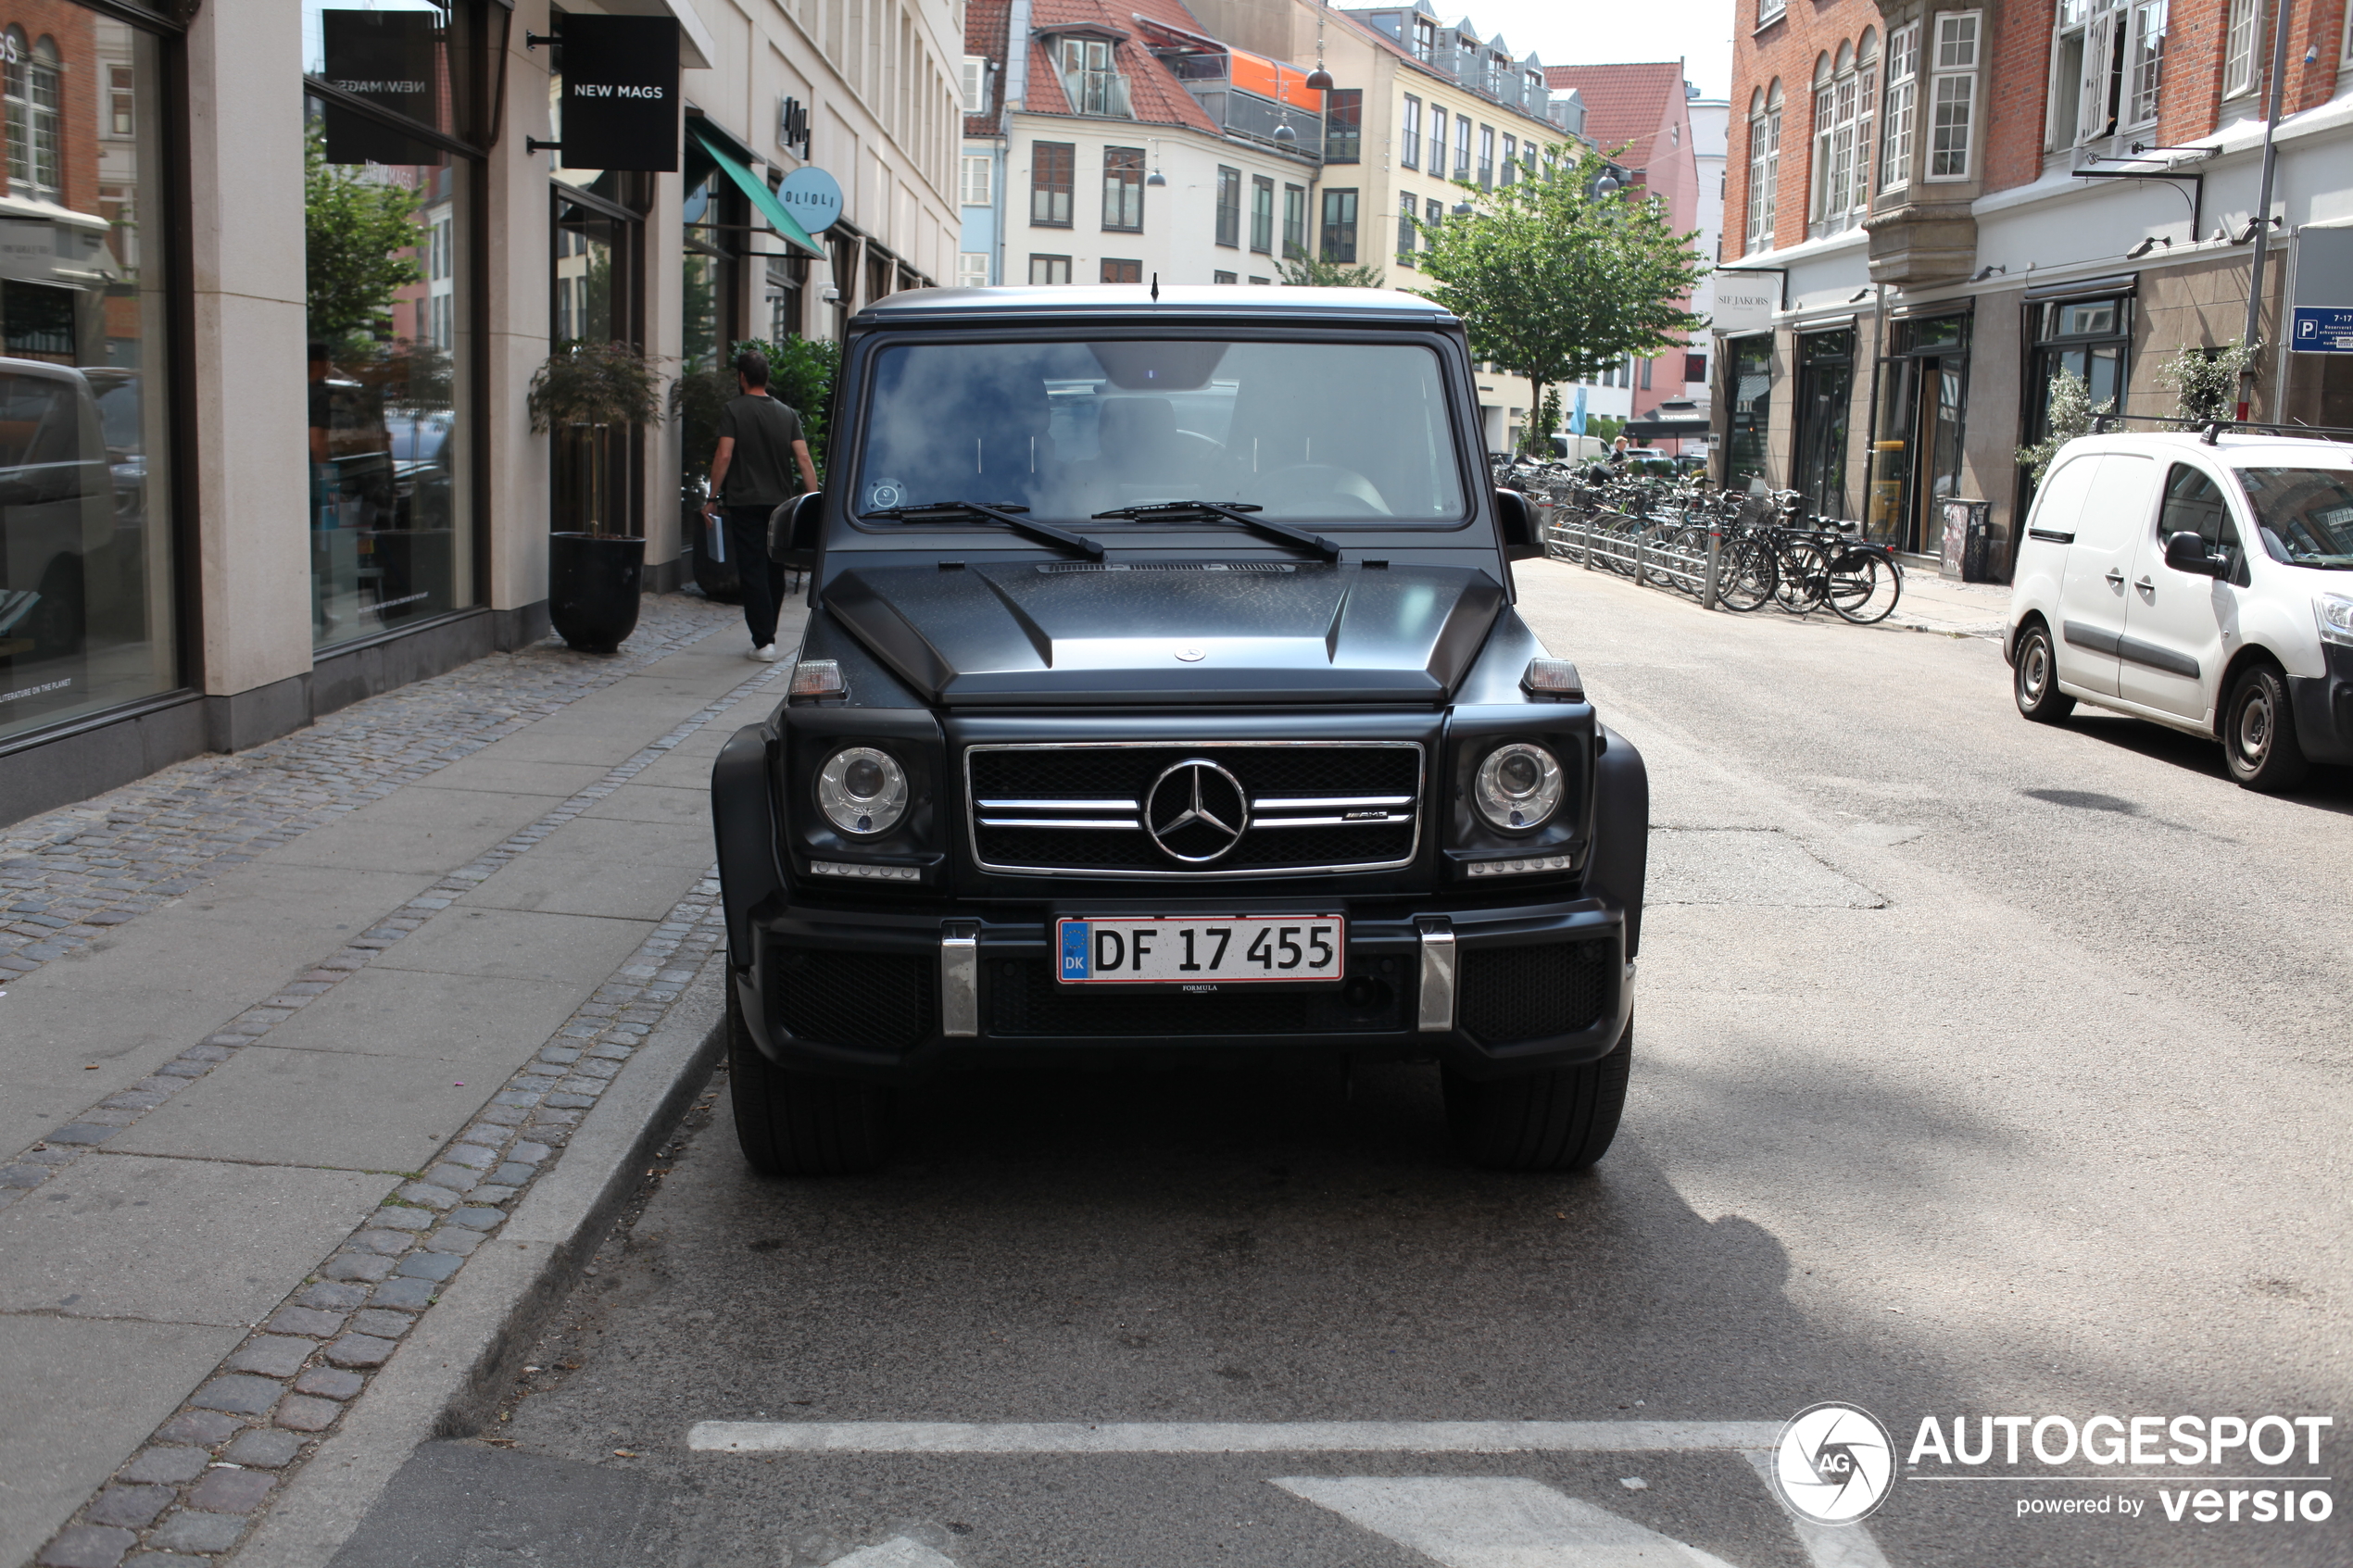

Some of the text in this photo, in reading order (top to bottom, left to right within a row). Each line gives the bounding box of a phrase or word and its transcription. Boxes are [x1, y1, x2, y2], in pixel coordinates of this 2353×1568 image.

[574, 84, 663, 99] NEW MAGS
[786, 191, 834, 208] OLIOLI
[1718, 295, 1768, 306] SIF JAKOBS
[2302, 321, 2313, 336] P
[0, 678, 71, 703] LITERATURE ON THE PLANET
[1095, 926, 1333, 971] DF 17 455
[1065, 957, 1085, 970] DK
